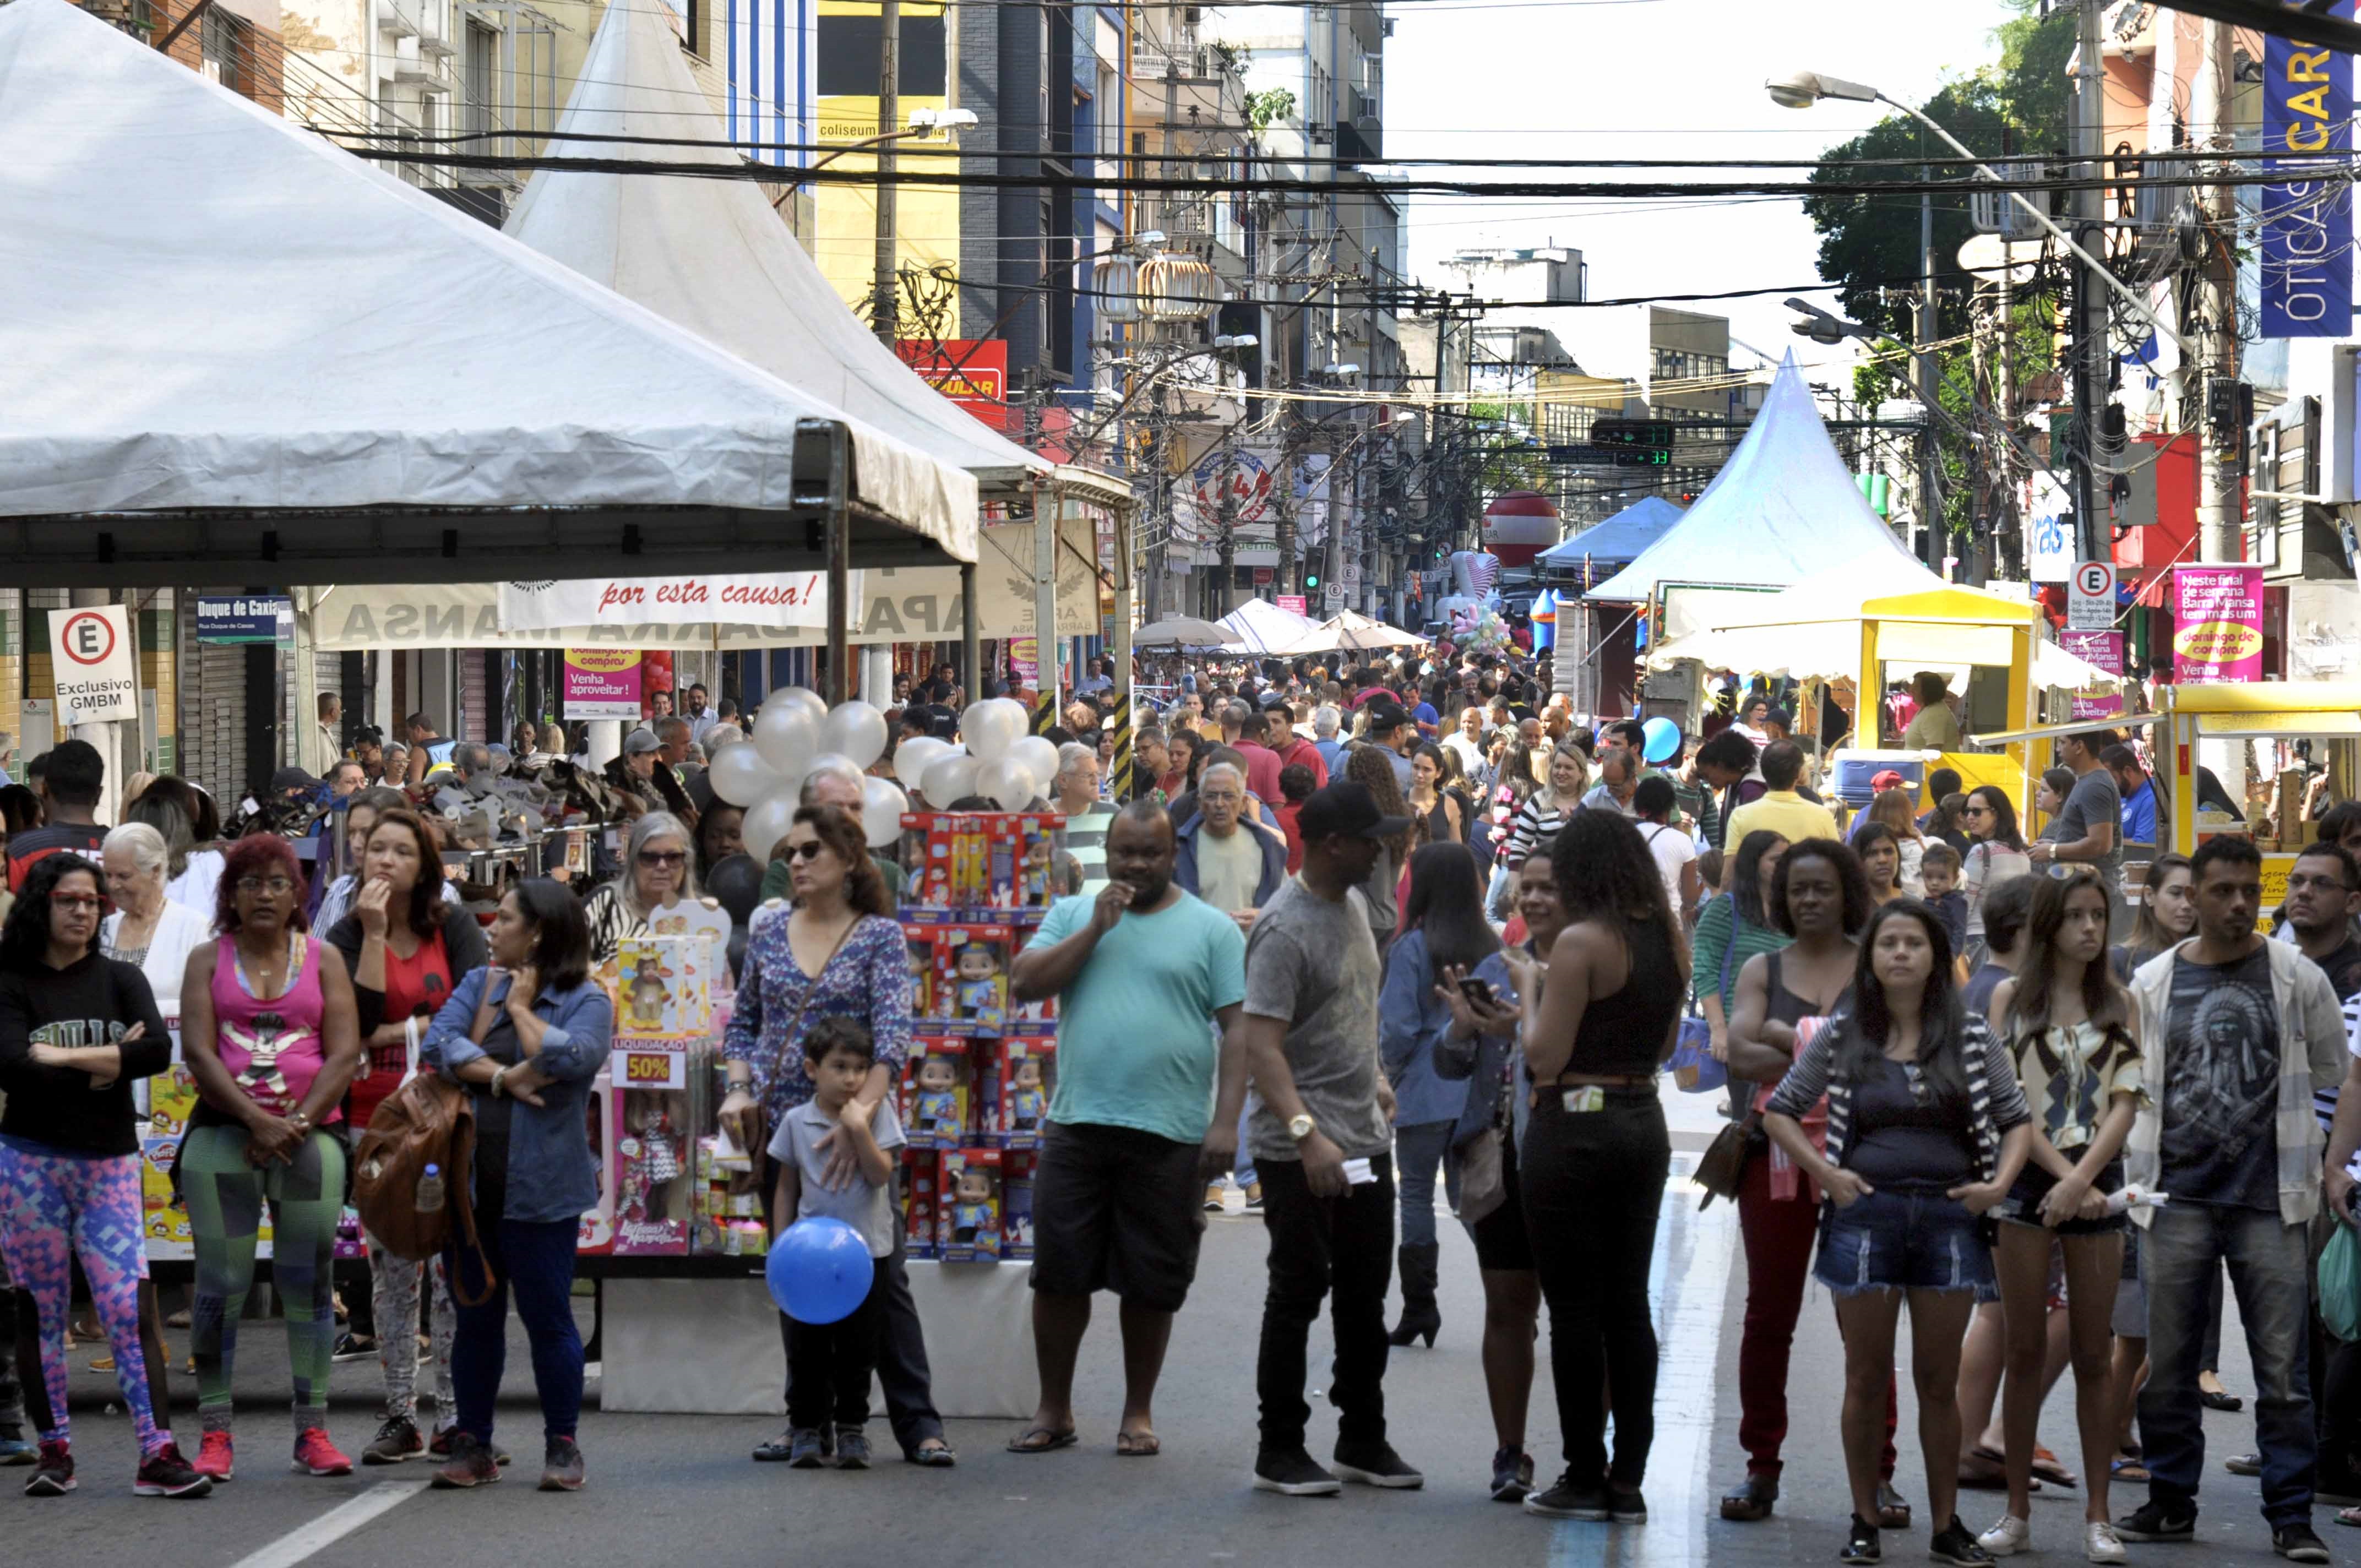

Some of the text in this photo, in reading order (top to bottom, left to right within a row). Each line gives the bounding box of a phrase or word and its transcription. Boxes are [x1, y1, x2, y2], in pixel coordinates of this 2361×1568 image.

[820, 124, 875, 135] coliseum
[2088, 571, 2100, 589] E
[2182, 574, 2243, 586] Neste final
[597, 574, 818, 613] por esta causa!
[2182, 586, 2244, 597] de semana
[2182, 597, 2255, 608] Barra Mansa
[198, 601, 231, 619] Duque
[233, 600, 246, 616] de
[2182, 608, 2256, 619] tem mais um
[78, 624, 99, 654] E
[2184, 631, 2255, 645] domingo de
[2193, 646, 2245, 657] compras
[581, 657, 626, 668] compras
[2182, 664, 2219, 676] Venha
[570, 673, 604, 684] Venha
[57, 679, 133, 695] Exclusivo
[570, 684, 623, 696] aproveitar
[70, 693, 122, 710] GMBM
[629, 1057, 670, 1079] 50%
